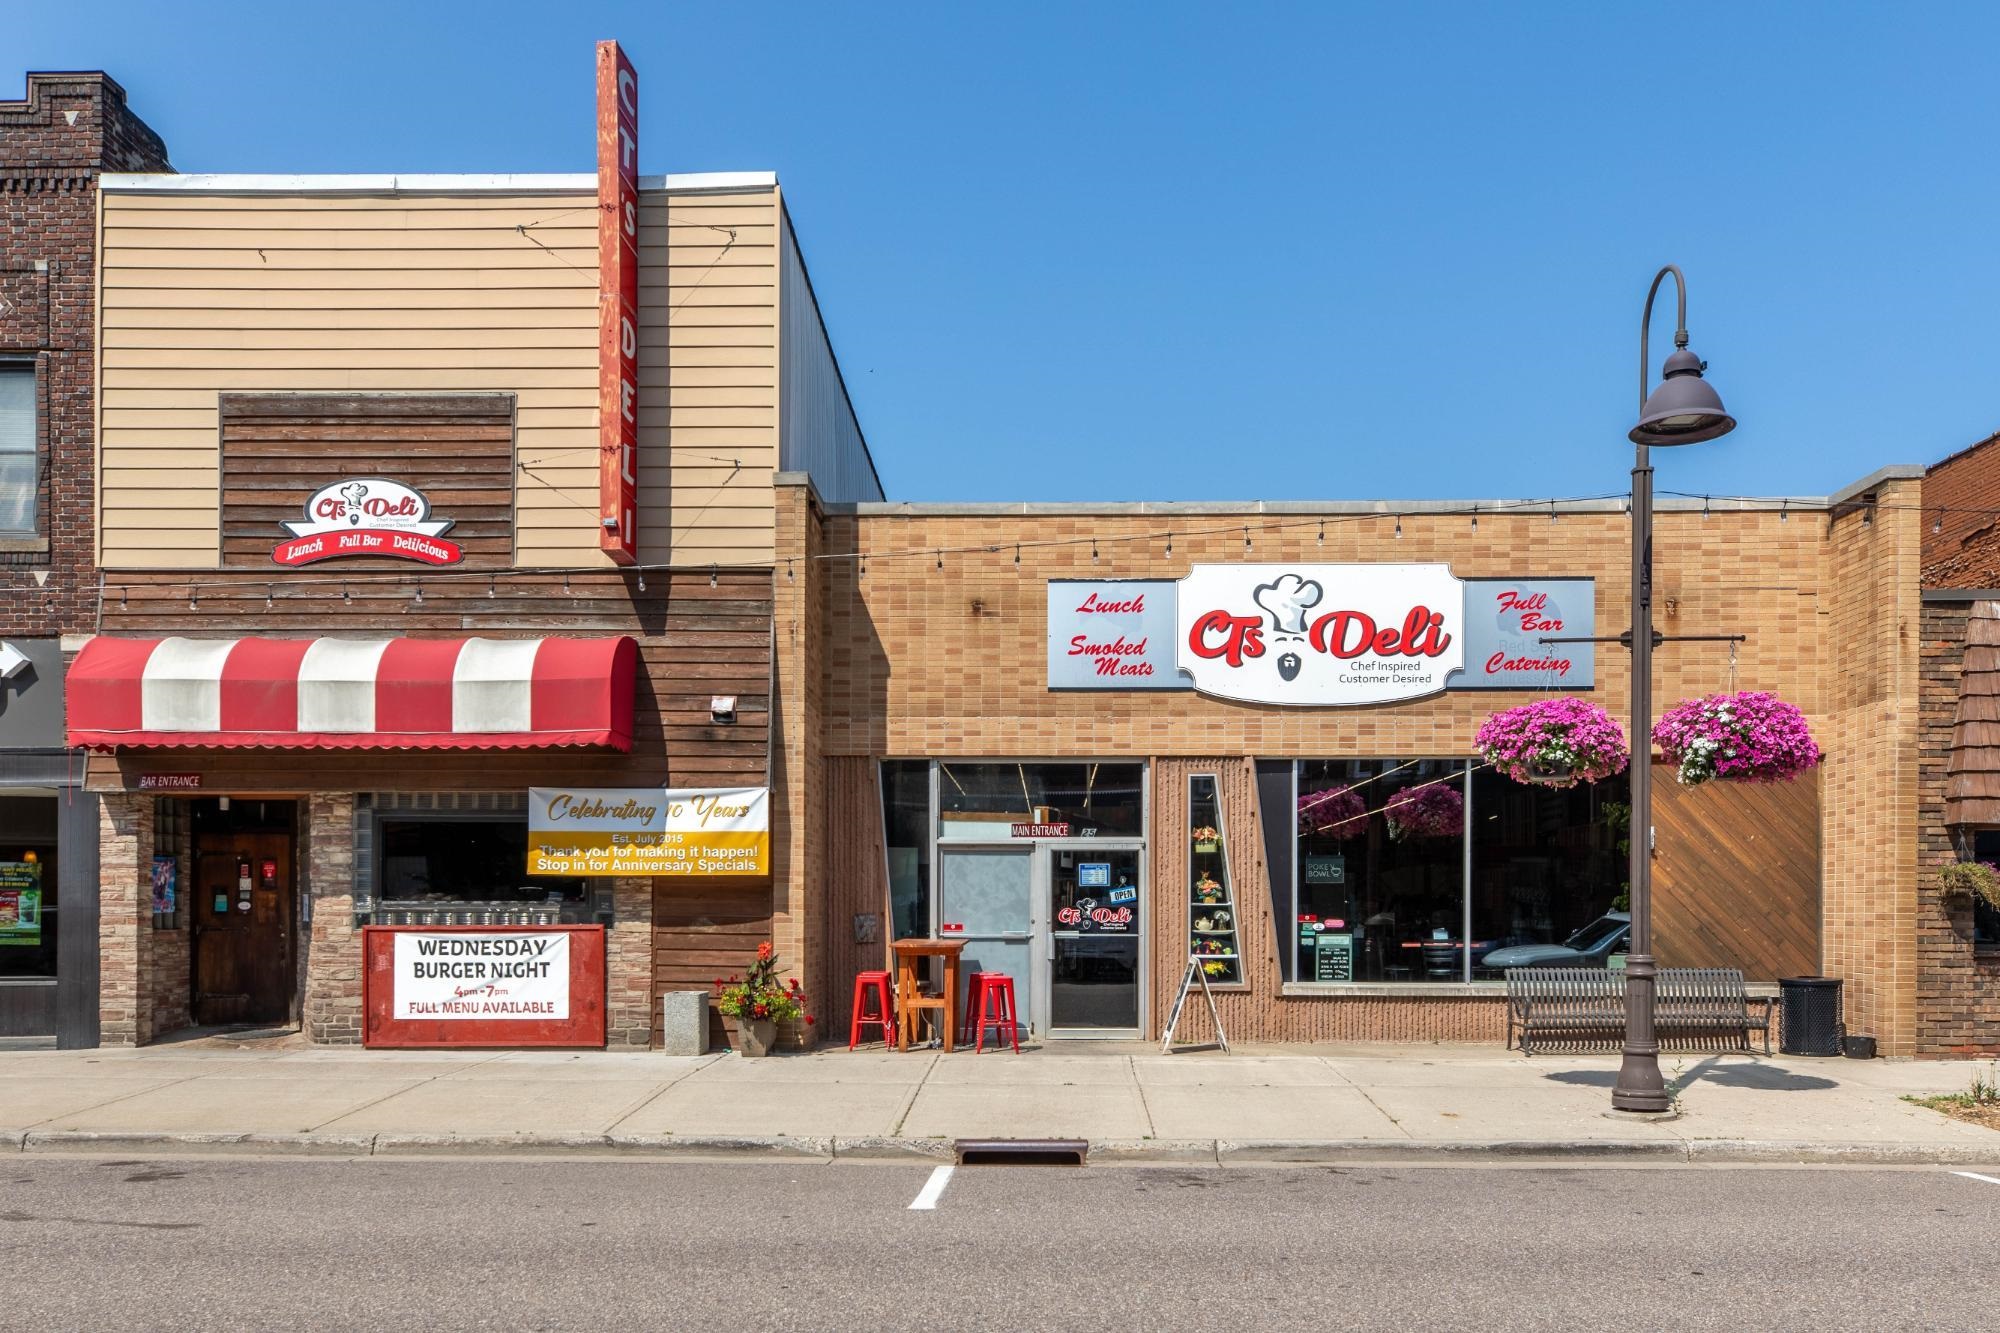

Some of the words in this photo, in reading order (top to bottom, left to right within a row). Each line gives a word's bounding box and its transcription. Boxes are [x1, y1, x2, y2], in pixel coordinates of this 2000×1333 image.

[620, 314, 636, 545] DELI
[363, 496, 419, 517] Deli
[286, 538, 323, 560] Lunch
[339, 534, 363, 548] Full
[363, 535, 383, 547] Bar
[393, 535, 449, 560] Deli/cious
[1076, 593, 1144, 613] Lunch
[1496, 592, 1547, 613] Full
[1520, 612, 1564, 631] Bar
[1308, 605, 1452, 660] Deli
[1068, 635, 1147, 655] Smoked
[1094, 657, 1154, 676] Meats
[1350, 661, 1377, 671] Chef
[1377, 661, 1421, 674] Inspired
[1485, 652, 1572, 677] Catering
[1339, 674, 1390, 684] Customer
[1392, 673, 1432, 684] Desired
[141, 776, 157, 787] BAR
[158, 776, 200, 787] ENTRANCE
[547, 794, 657, 827] Celebrating
[665, 804, 683, 818] 10
[691, 794, 750, 828] Years
[1012, 825, 1030, 836] MAIN
[1031, 825, 1068, 836] ENTRANCE
[612, 834, 631, 843] Est.
[635, 834, 656, 845] July
[658, 834, 683, 843] 2015
[540, 846, 580, 857] Thank
[585, 848, 609, 859] you
[613, 846, 634, 857] for
[636, 846, 688, 859] making
[690, 846, 699, 857] it
[702, 846, 758, 859] happen!
[537, 859, 569, 872] Stop
[573, 859, 585, 870] in
[589, 859, 608, 870] for
[612, 859, 694, 873] Anniversary
[698, 859, 760, 873] Specials.
[1114, 889, 1133, 901] OPEN
[1092, 906, 1132, 923] Deli
[418, 940, 547, 956] WEDNESDAY
[414, 962, 486, 978] BURGER
[491, 962, 550, 978] NIGHT
[409, 1002, 439, 1014] FULL
[442, 1002, 479, 1014] MENU
[482, 1002, 554, 1014] AVAILABLE
